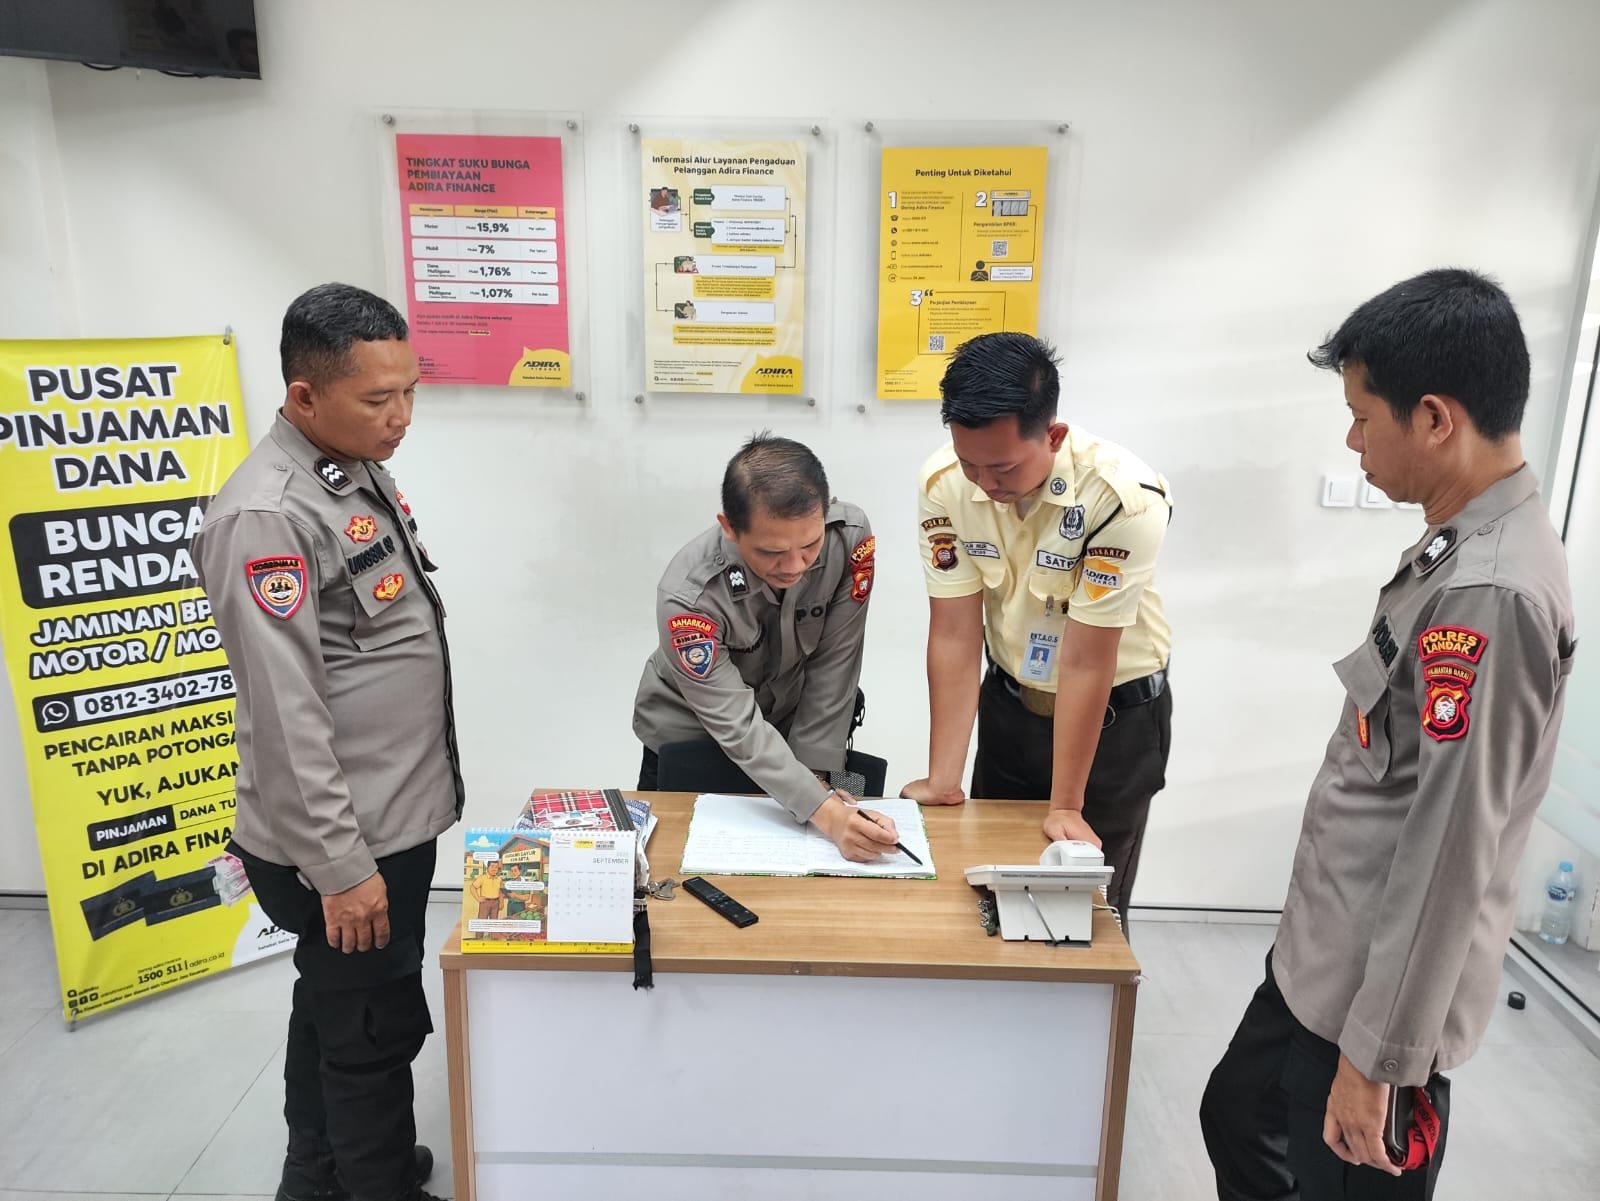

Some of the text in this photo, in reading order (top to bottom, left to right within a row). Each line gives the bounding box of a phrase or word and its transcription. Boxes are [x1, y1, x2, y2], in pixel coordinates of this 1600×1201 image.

[406, 158, 530, 170] TINGKAT SUKU BUNGA
[652, 155, 796, 167] Informasi Alur Layanan Pengaduan
[407, 170, 481, 181] PEMBIAYAAN
[674, 166, 775, 175] Pelanggan Adira Finance
[915, 169, 946, 177] Penting
[974, 168, 1012, 176] Diketahui
[408, 182, 496, 193] ADIRA FINANCE
[888, 191, 897, 209] 1
[975, 191, 988, 209] 2
[477, 222, 509, 233] 15,9%
[478, 244, 495, 254] 7%
[480, 266, 511, 277] 1,76%
[481, 288, 513, 299] 1,07%
[909, 290, 922, 306] 3
[28, 365, 177, 401] PUSAT
[0, 404, 230, 447] PINJAMAN
[55, 451, 187, 489] DANA
[44, 506, 205, 554] BUNGA
[1045, 555, 1075, 569] SATP
[38, 548, 199, 599] RENDA
[1084, 568, 1117, 582] ADIRA
[31, 598, 212, 646] JAMINAN BP
[671, 618, 712, 633] BAHARKAM
[675, 634, 705, 644] BINMA
[1422, 630, 1478, 648] POLRES
[31, 627, 221, 678] MOTOR / MO
[1427, 641, 1471, 655] LANDAK
[84, 673, 233, 715] 0812-3402-78
[44, 710, 233, 760] PENCAIRAN MAKSI
[72, 752, 141, 777] TANPA
[97, 782, 151, 806] YUK,
[96, 798, 236, 842] PINJAMAN DANA TU
[82, 826, 232, 879] DI ADIRA FINA
[257, 925, 280, 938] AD
[138, 952, 225, 984] 1500 511 adira.co.id
